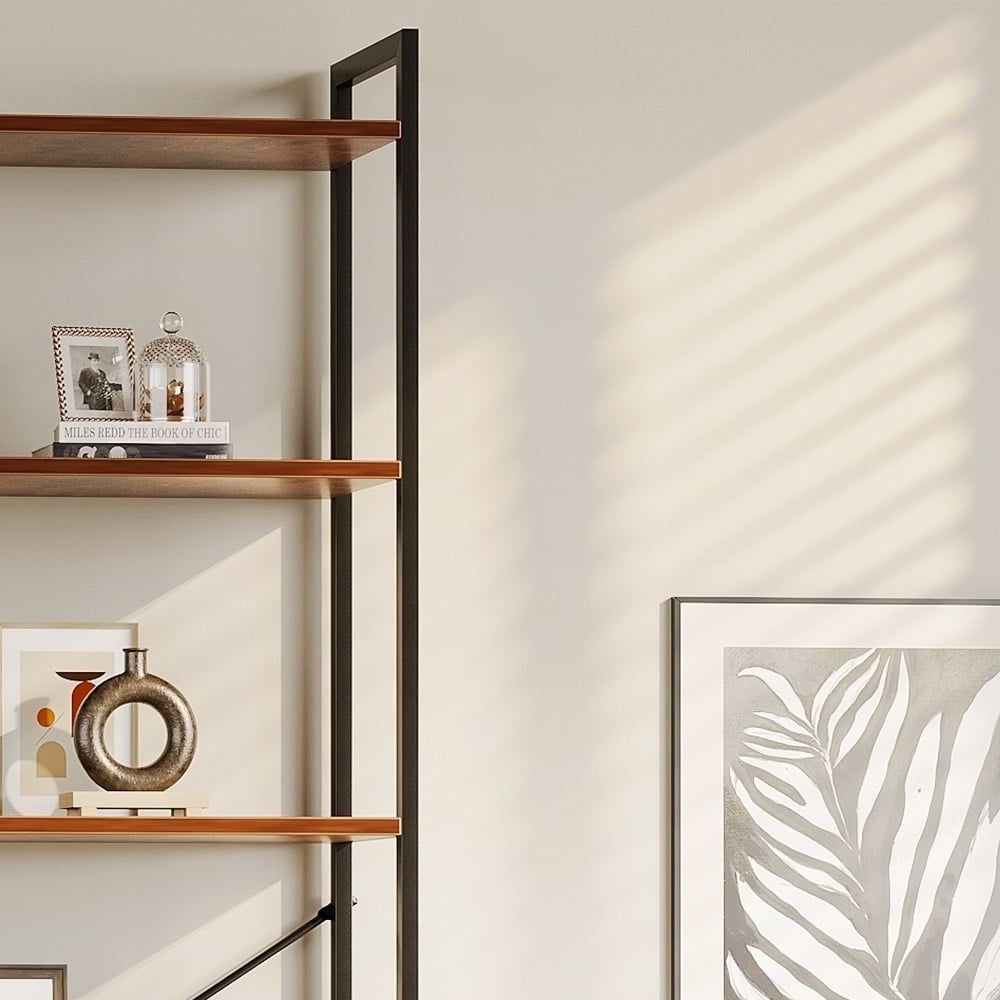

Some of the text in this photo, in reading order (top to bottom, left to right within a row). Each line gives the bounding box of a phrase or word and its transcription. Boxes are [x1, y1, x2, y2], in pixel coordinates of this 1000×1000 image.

[64, 427, 222, 439] MILES REDD THE BOOK OF CHIC
